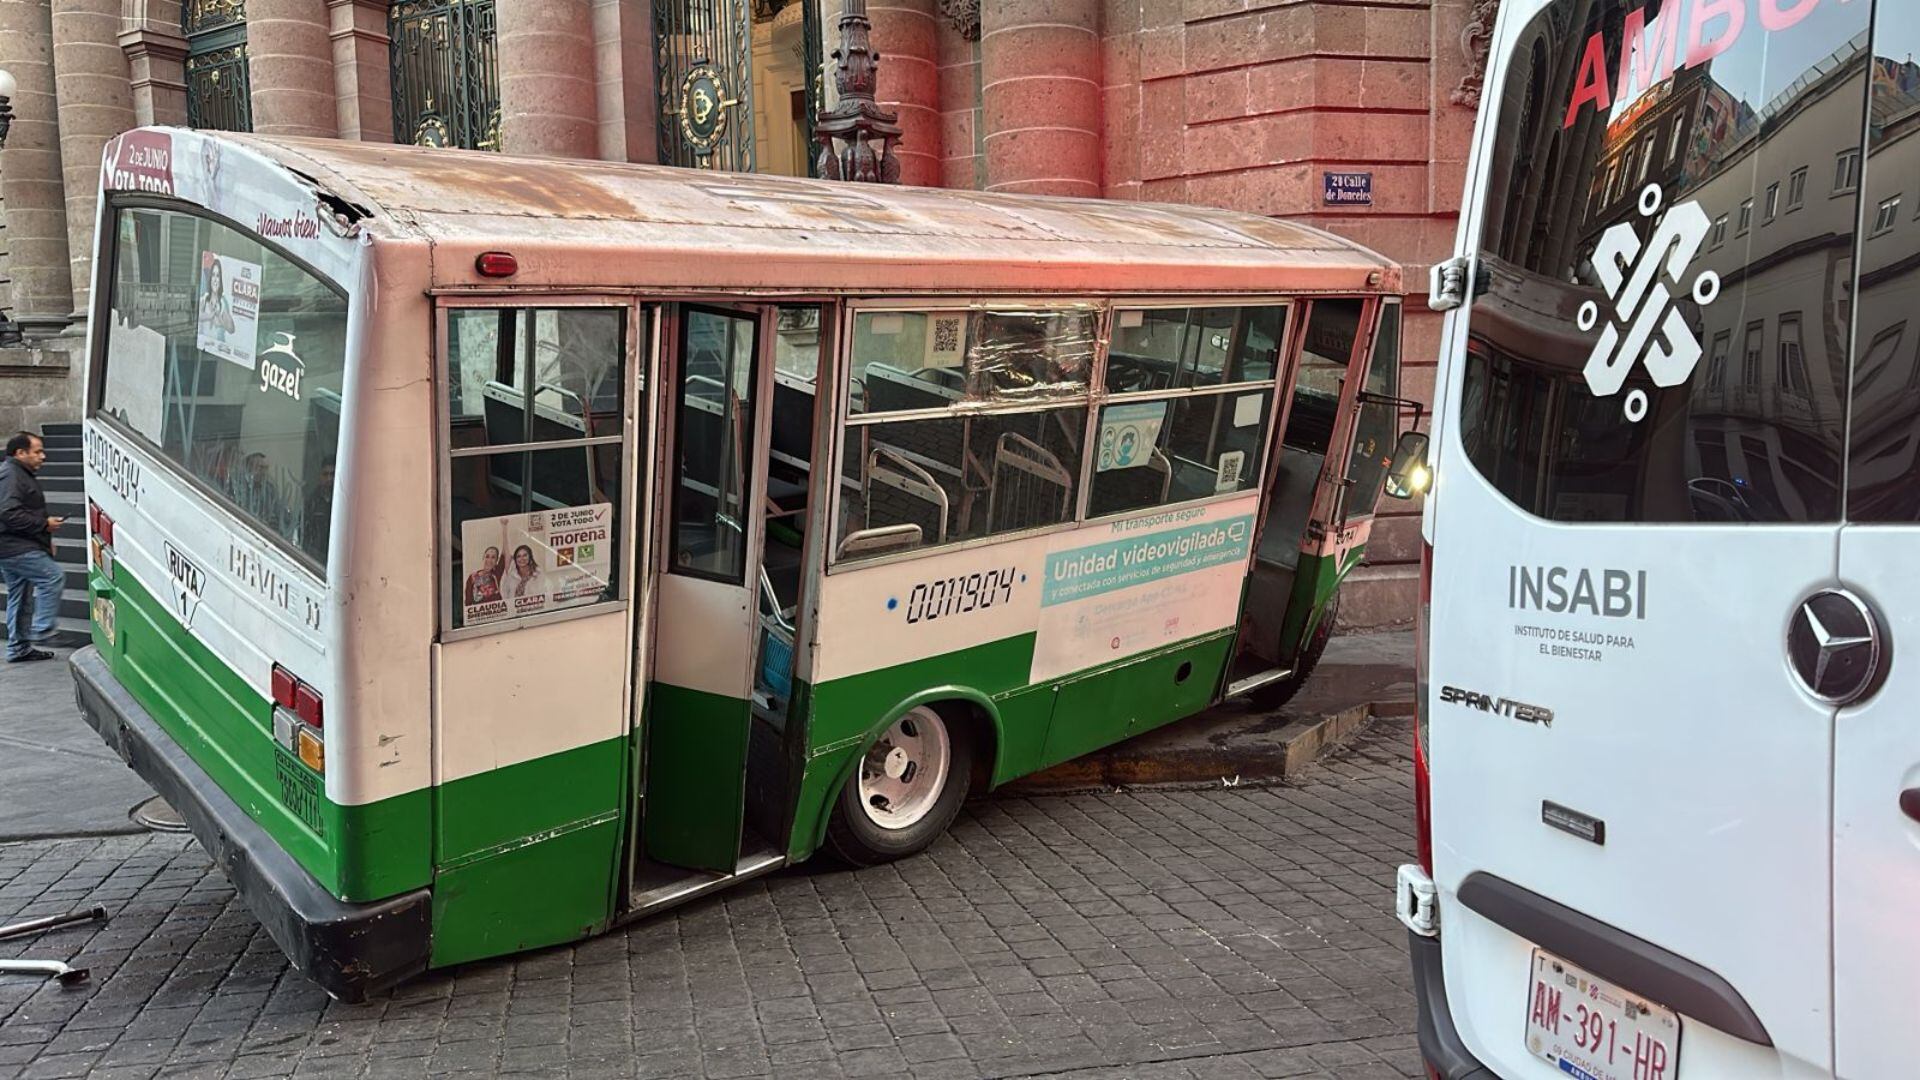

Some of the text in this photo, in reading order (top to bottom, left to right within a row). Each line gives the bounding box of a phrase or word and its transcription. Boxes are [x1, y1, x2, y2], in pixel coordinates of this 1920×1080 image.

[129, 144, 136, 165] 2
[143, 146, 169, 171] JUNIO
[1344, 175, 1367, 187] Calle
[1325, 188, 1336, 200] de
[260, 359, 301, 401] gazel
[551, 509, 594, 521] 2 DE JUNIO
[551, 516, 594, 528] VOTA TODO
[1125, 512, 1174, 531] transporte
[1175, 507, 1207, 522] seguro
[550, 528, 607, 547] morena
[1053, 527, 1226, 581] Unidad videovigilada
[169, 549, 199, 598] RUTA
[180, 591, 187, 617] 1
[516, 594, 545, 607] CLARA
[907, 566, 1016, 624] 0011904
[1508, 565, 1647, 620] INSABI
[467, 600, 507, 614] CLAUDIA
[1514, 624, 1635, 649] INSTITUTO DE SALUD PARA
[1539, 643, 1602, 662] EL BIENESTAR
[1440, 684, 1555, 729] SPRINTER
[1532, 980, 1667, 1080] AM-391-HR
